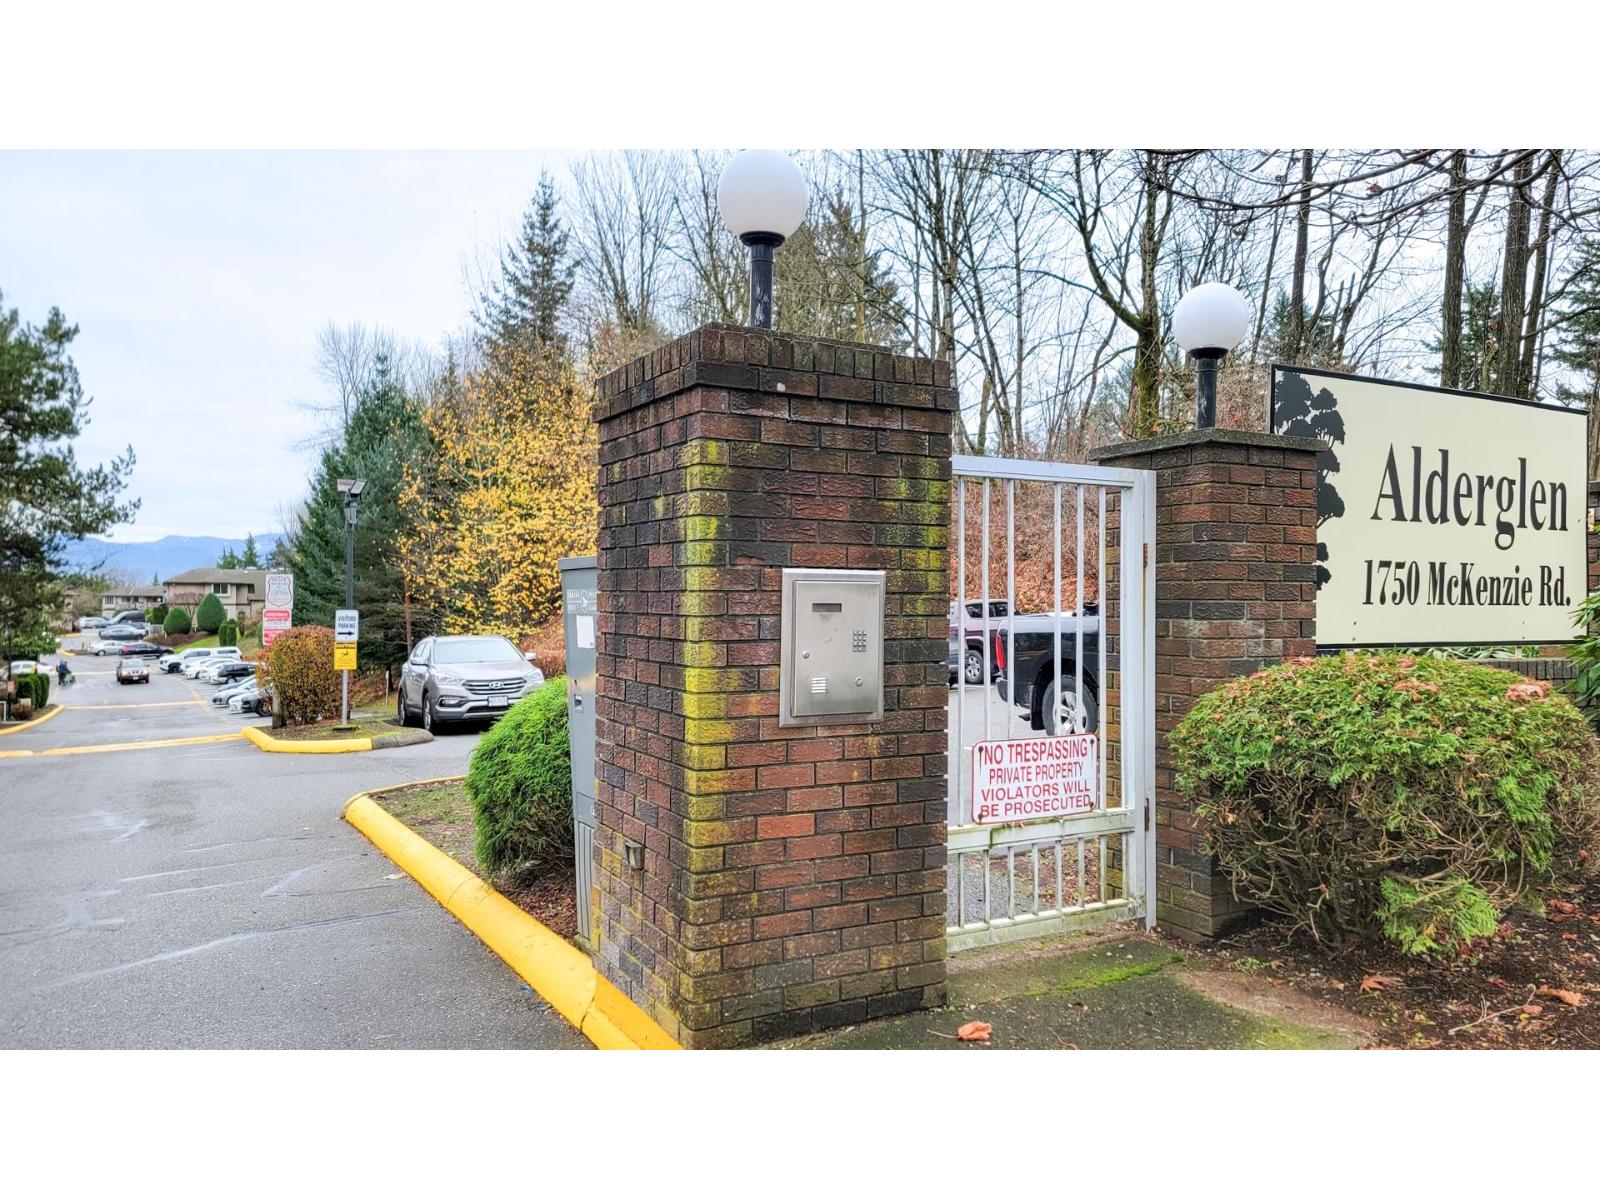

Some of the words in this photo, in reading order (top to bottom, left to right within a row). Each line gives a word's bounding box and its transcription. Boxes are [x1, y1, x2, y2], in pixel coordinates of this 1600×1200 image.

[1370, 442, 1568, 550] Alderglen
[1362, 560, 1420, 605] 1750
[1427, 561, 1533, 606] McKenzie
[1538, 565, 1571, 606] Rd.
[985, 745, 1004, 765] NO
[1007, 738, 1088, 763] TRESPASSING
[989, 766, 1032, 785] PRIVATE
[1035, 761, 1084, 781] PROPERTY
[982, 783, 1059, 802] VIOLATORS
[1063, 779, 1091, 795] WILL
[980, 804, 999, 818] BE
[1004, 794, 1091, 816] PROSECUTED
